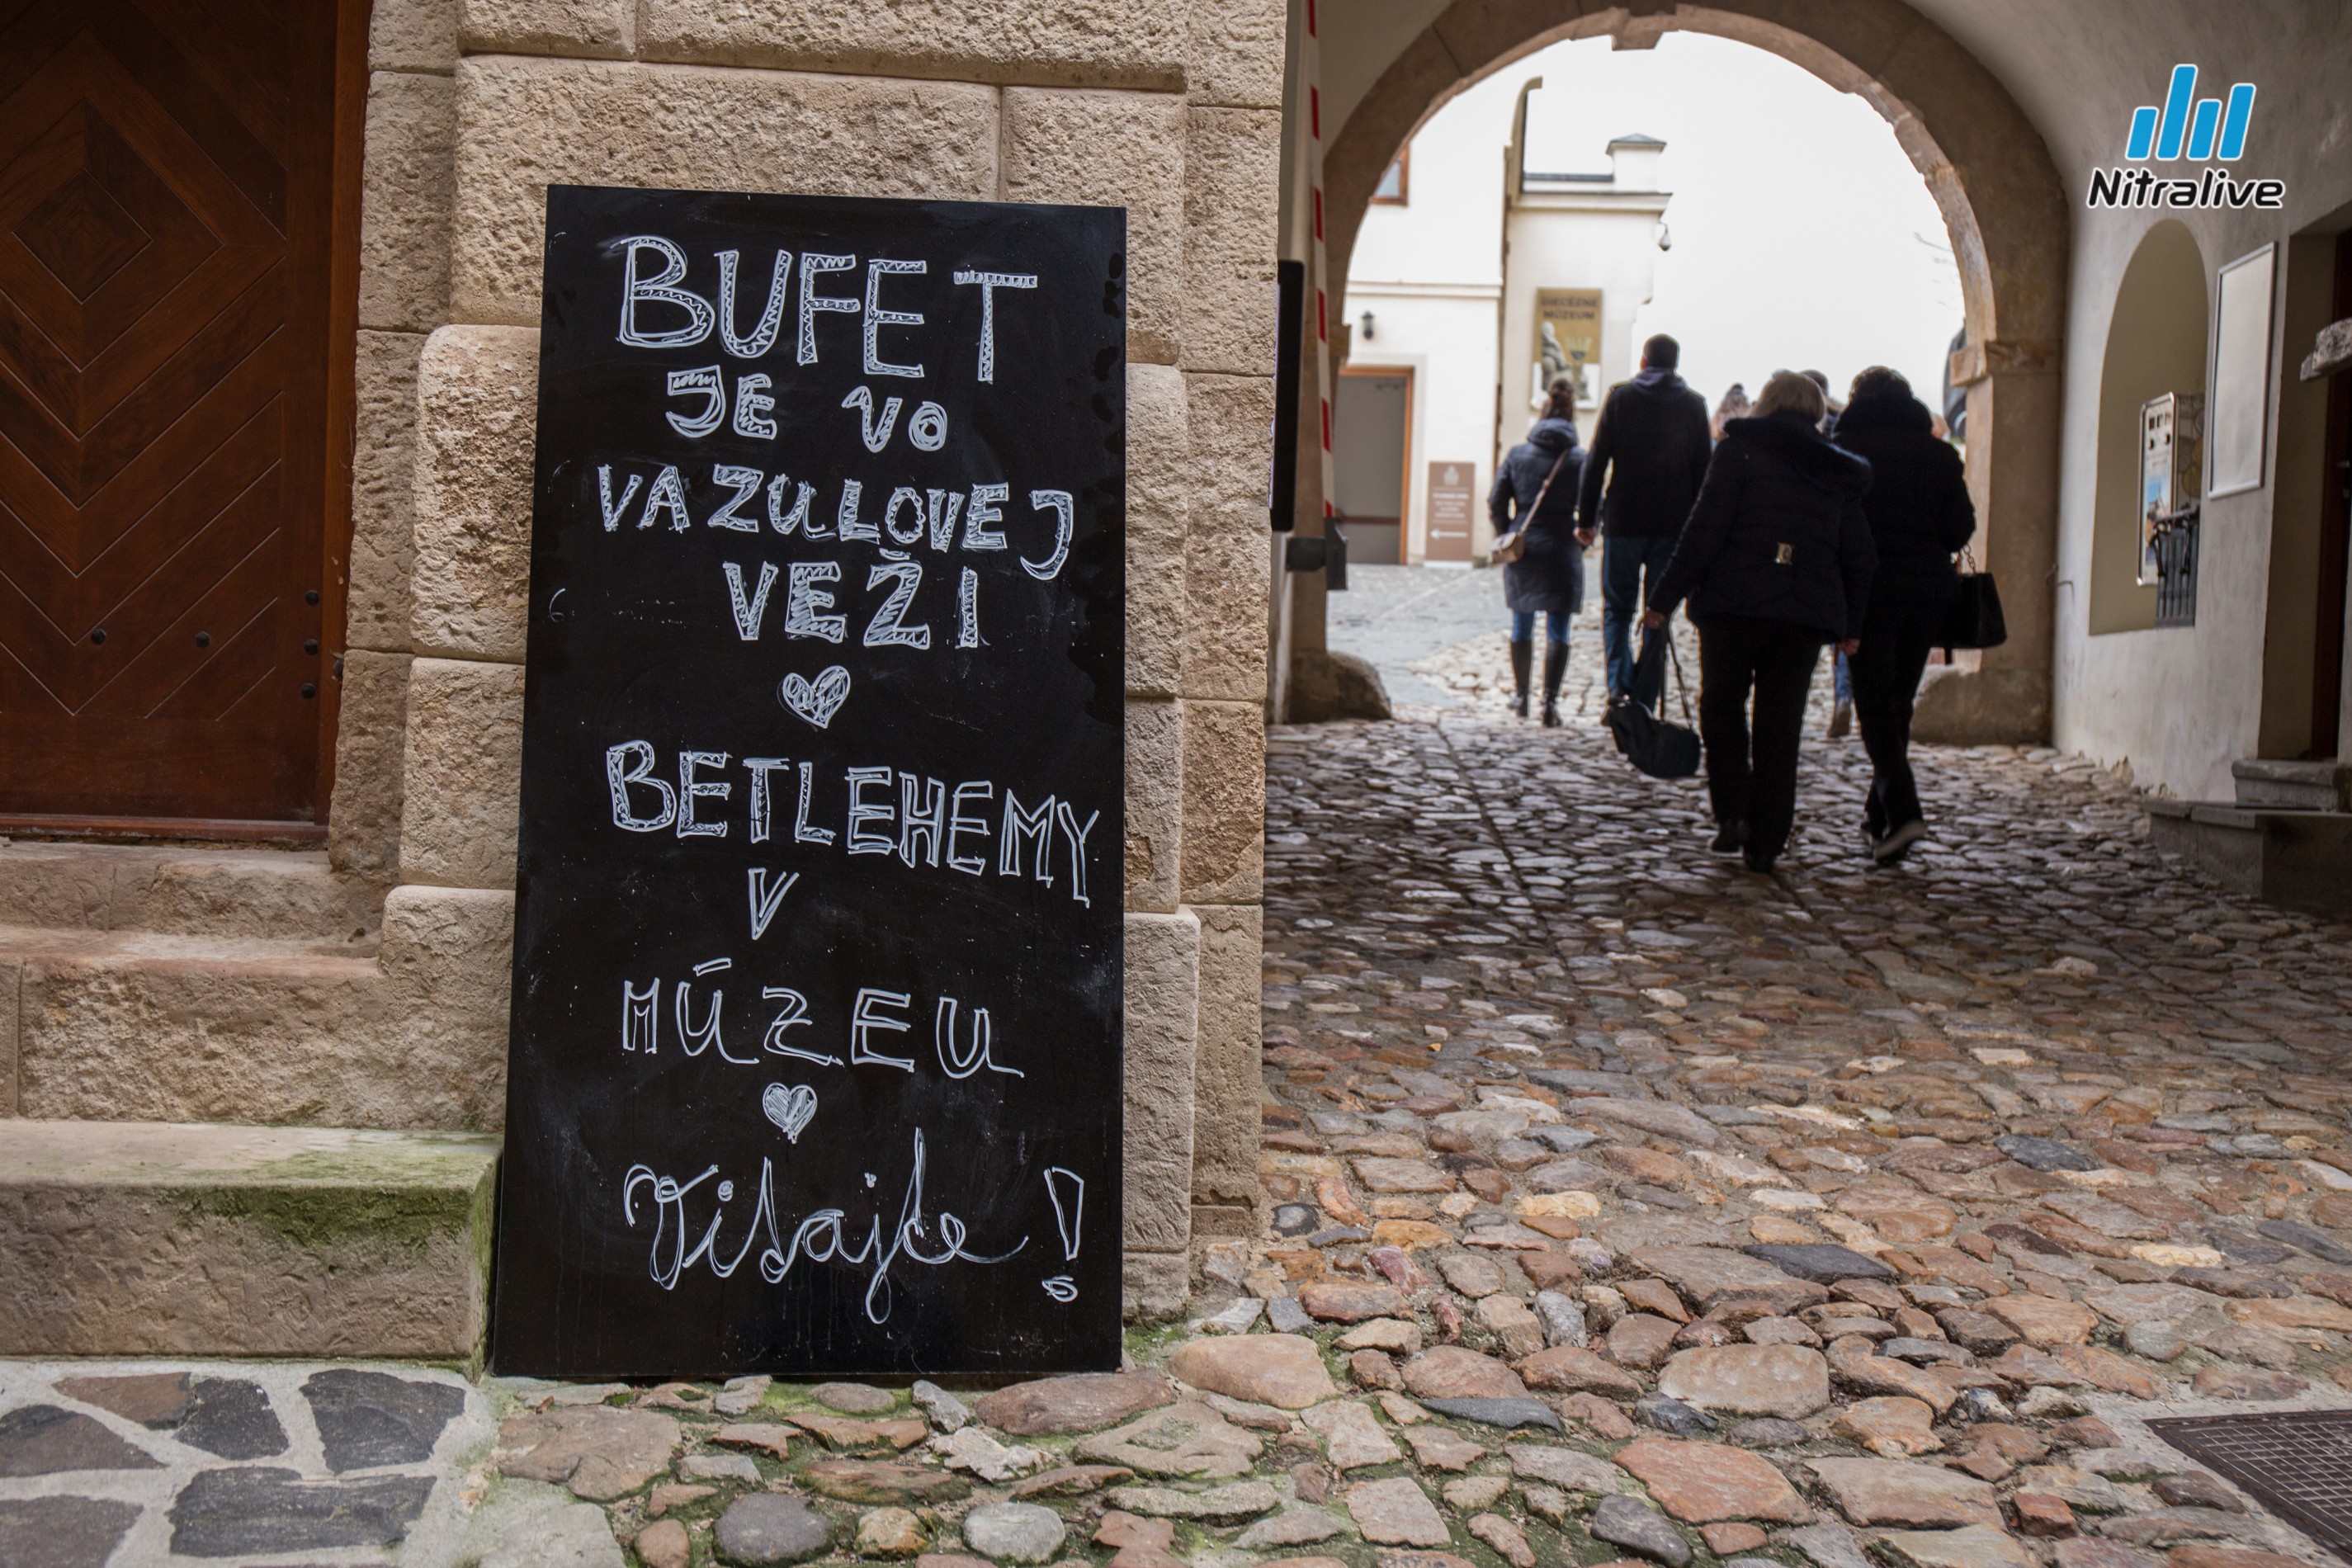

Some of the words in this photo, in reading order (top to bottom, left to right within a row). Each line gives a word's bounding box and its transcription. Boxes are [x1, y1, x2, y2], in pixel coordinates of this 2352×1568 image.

[617, 235, 1037, 383] BUFET
[666, 365, 777, 439] JE
[841, 385, 948, 452] VO
[597, 463, 1073, 580] VAZULOVEJ
[723, 548, 980, 650] VEŽI
[606, 739, 1099, 908] BETLEHEMY
[747, 867, 799, 940] V
[622, 957, 1024, 1078] MÚZEU
